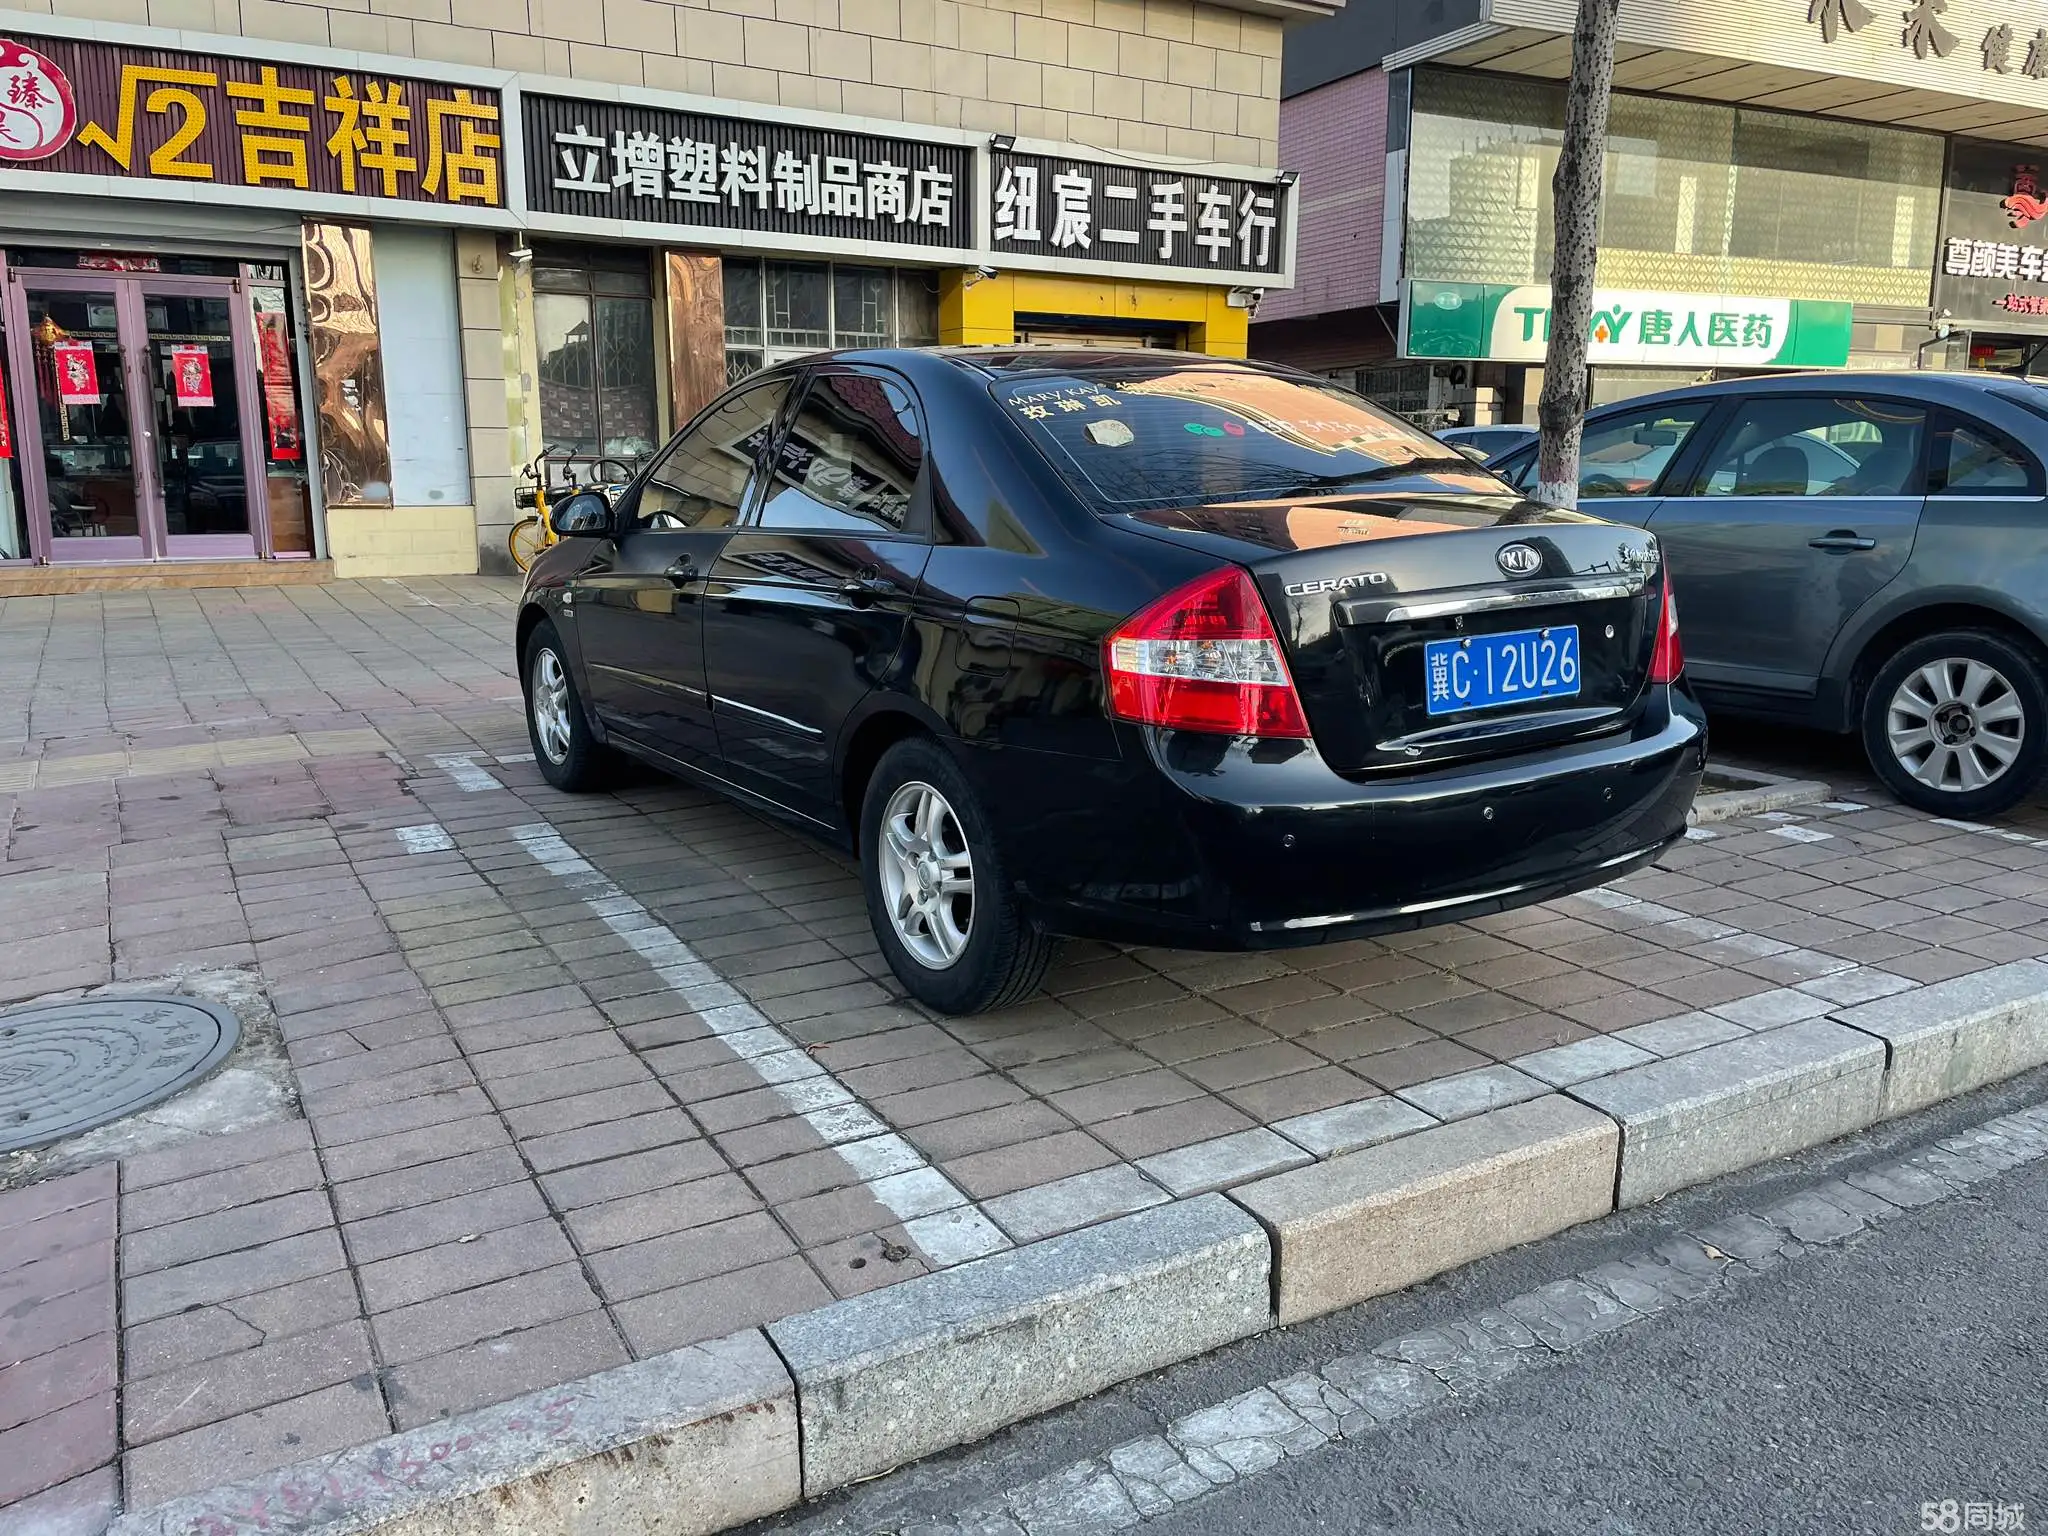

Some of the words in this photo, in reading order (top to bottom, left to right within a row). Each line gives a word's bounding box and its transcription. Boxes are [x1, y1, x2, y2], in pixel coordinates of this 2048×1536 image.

[554, 124, 953, 227] 立增塑料制品商店
[994, 165, 1276, 267] 纽宸二手车行
[1945, 237, 2048, 283] 尊颜美车
[1638, 309, 1773, 349] 唐人医药
[1008, 390, 1061, 406] MARY
[1065, 384, 1100, 397] KAY
[1018, 394, 1122, 430] 玫琳凯
[1505, 549, 1538, 569] KIA
[1285, 572, 1387, 596] CERATO
